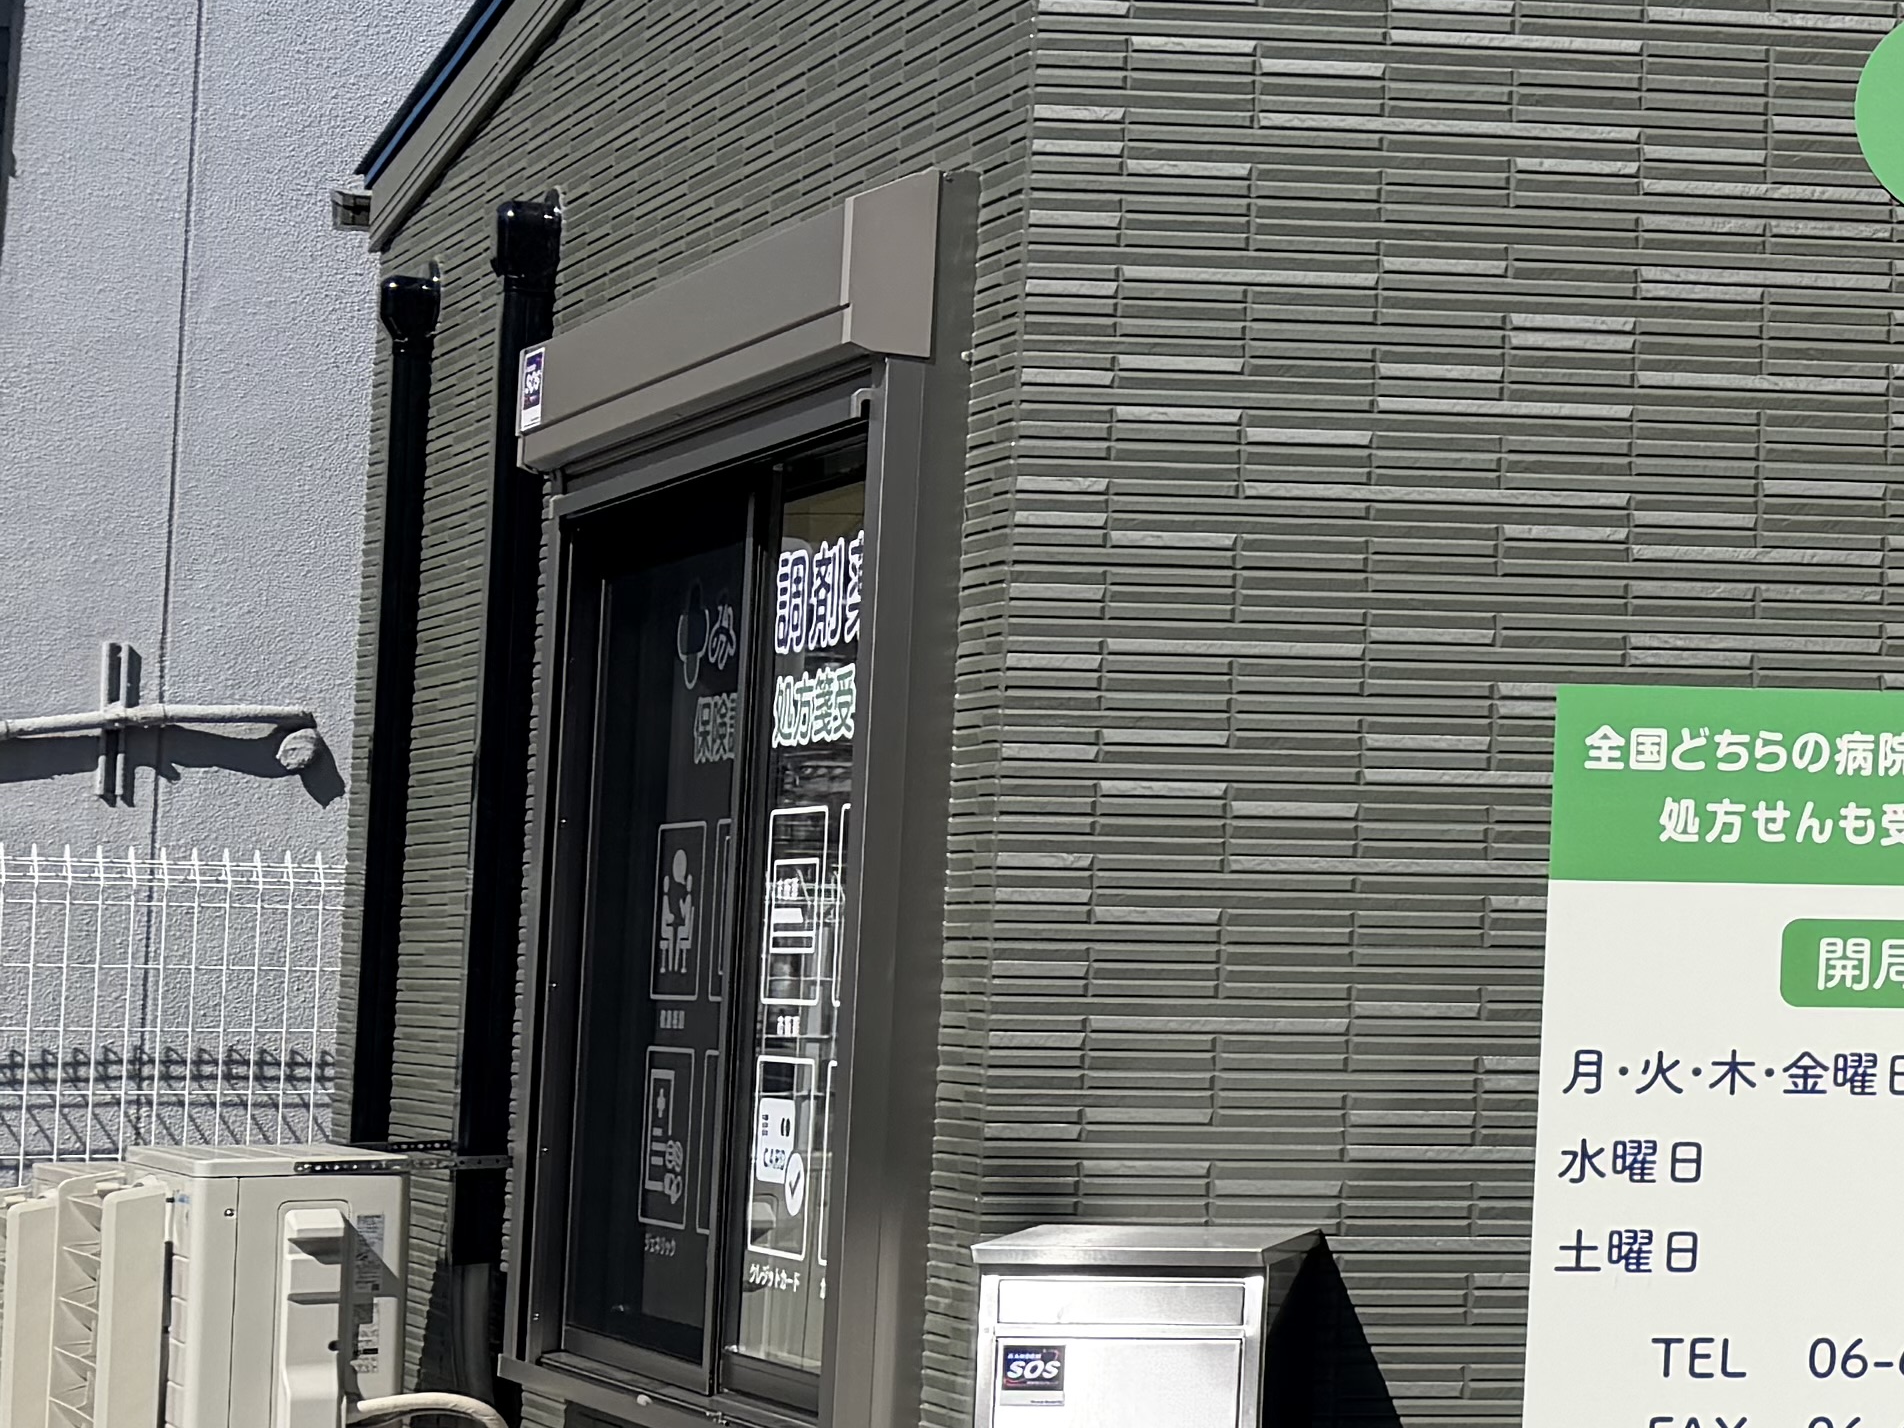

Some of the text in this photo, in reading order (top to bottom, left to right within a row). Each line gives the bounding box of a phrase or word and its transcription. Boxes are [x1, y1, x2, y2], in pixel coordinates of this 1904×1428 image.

[1557, 1138, 1703, 1184] 水曜日
[1553, 1228, 1698, 1274] 土曜日
[1006, 1360, 1061, 1379] SOS
[1651, 1337, 1747, 1379] TEL
